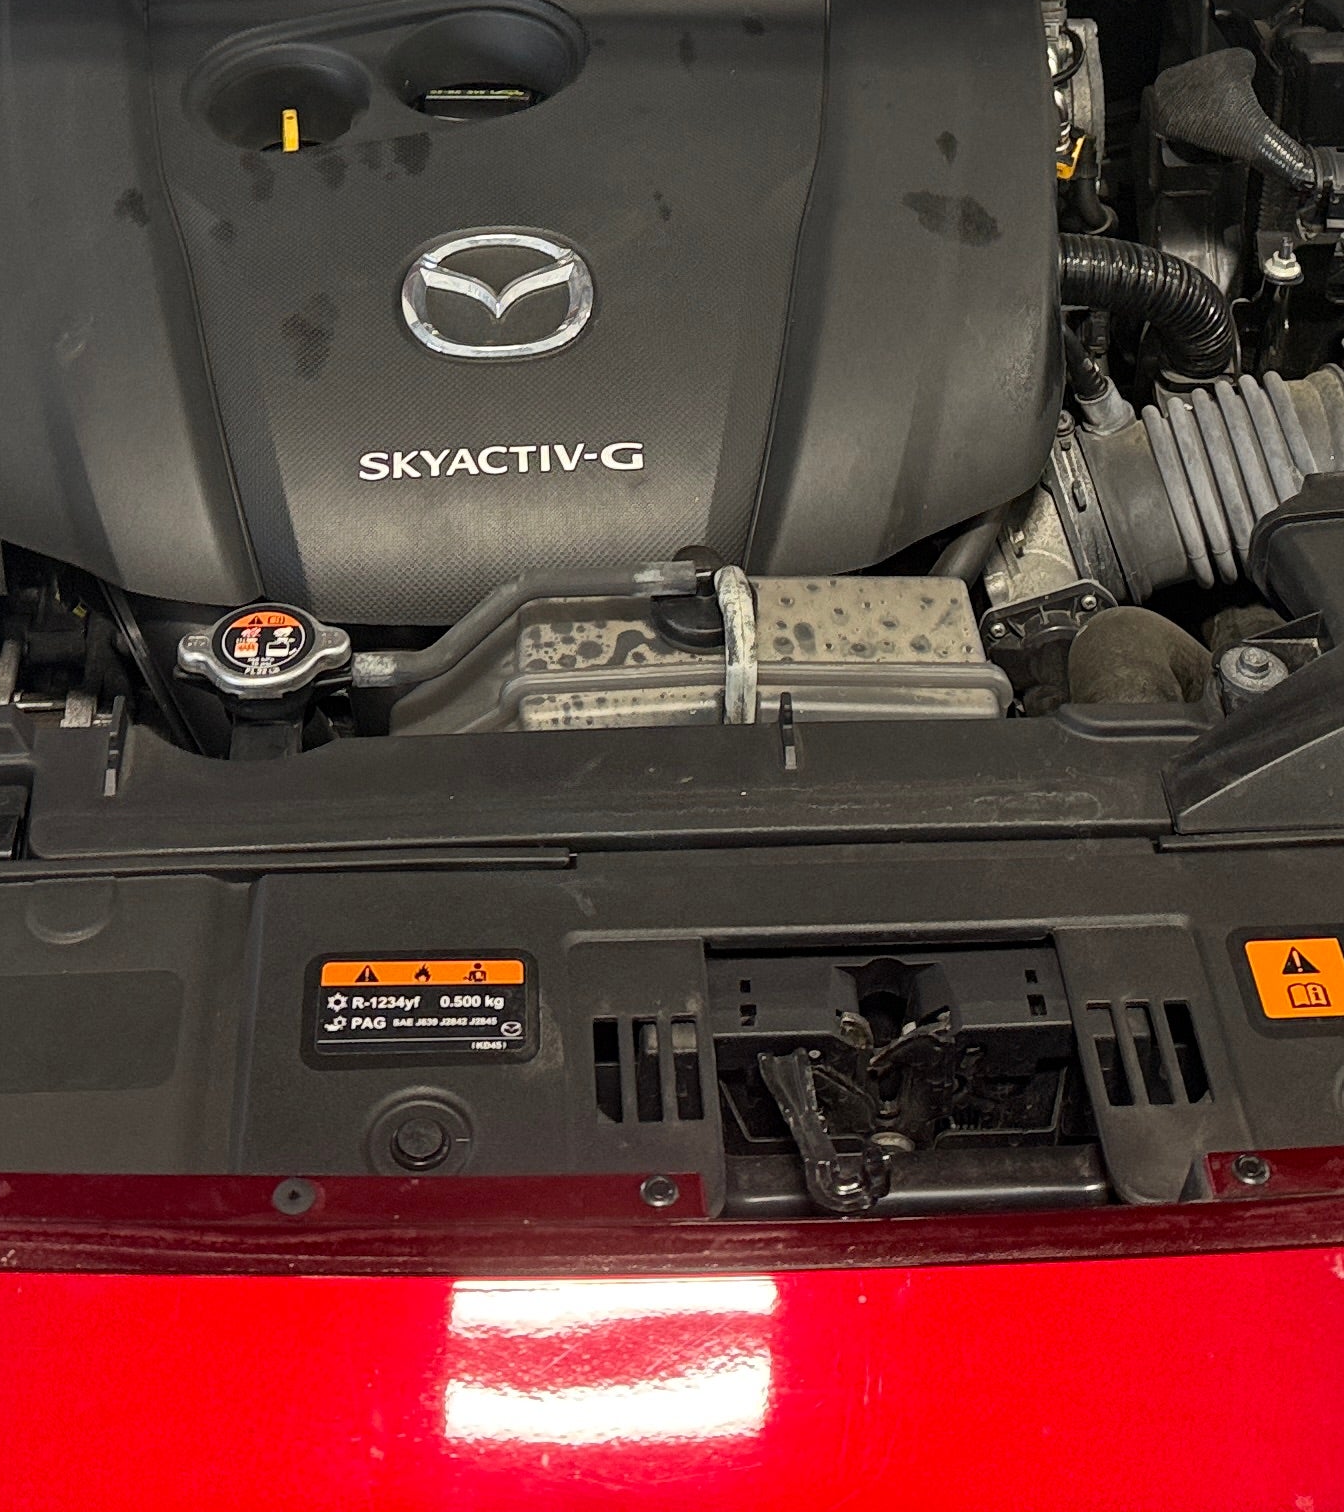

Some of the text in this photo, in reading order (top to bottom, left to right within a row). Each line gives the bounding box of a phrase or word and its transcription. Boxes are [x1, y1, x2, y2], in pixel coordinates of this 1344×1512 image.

[359, 442, 645, 481] SKYACTIV-G
[352, 995, 505, 1011] R-1234yf 0.500 kg
[351, 1017, 386, 1030] PAG
